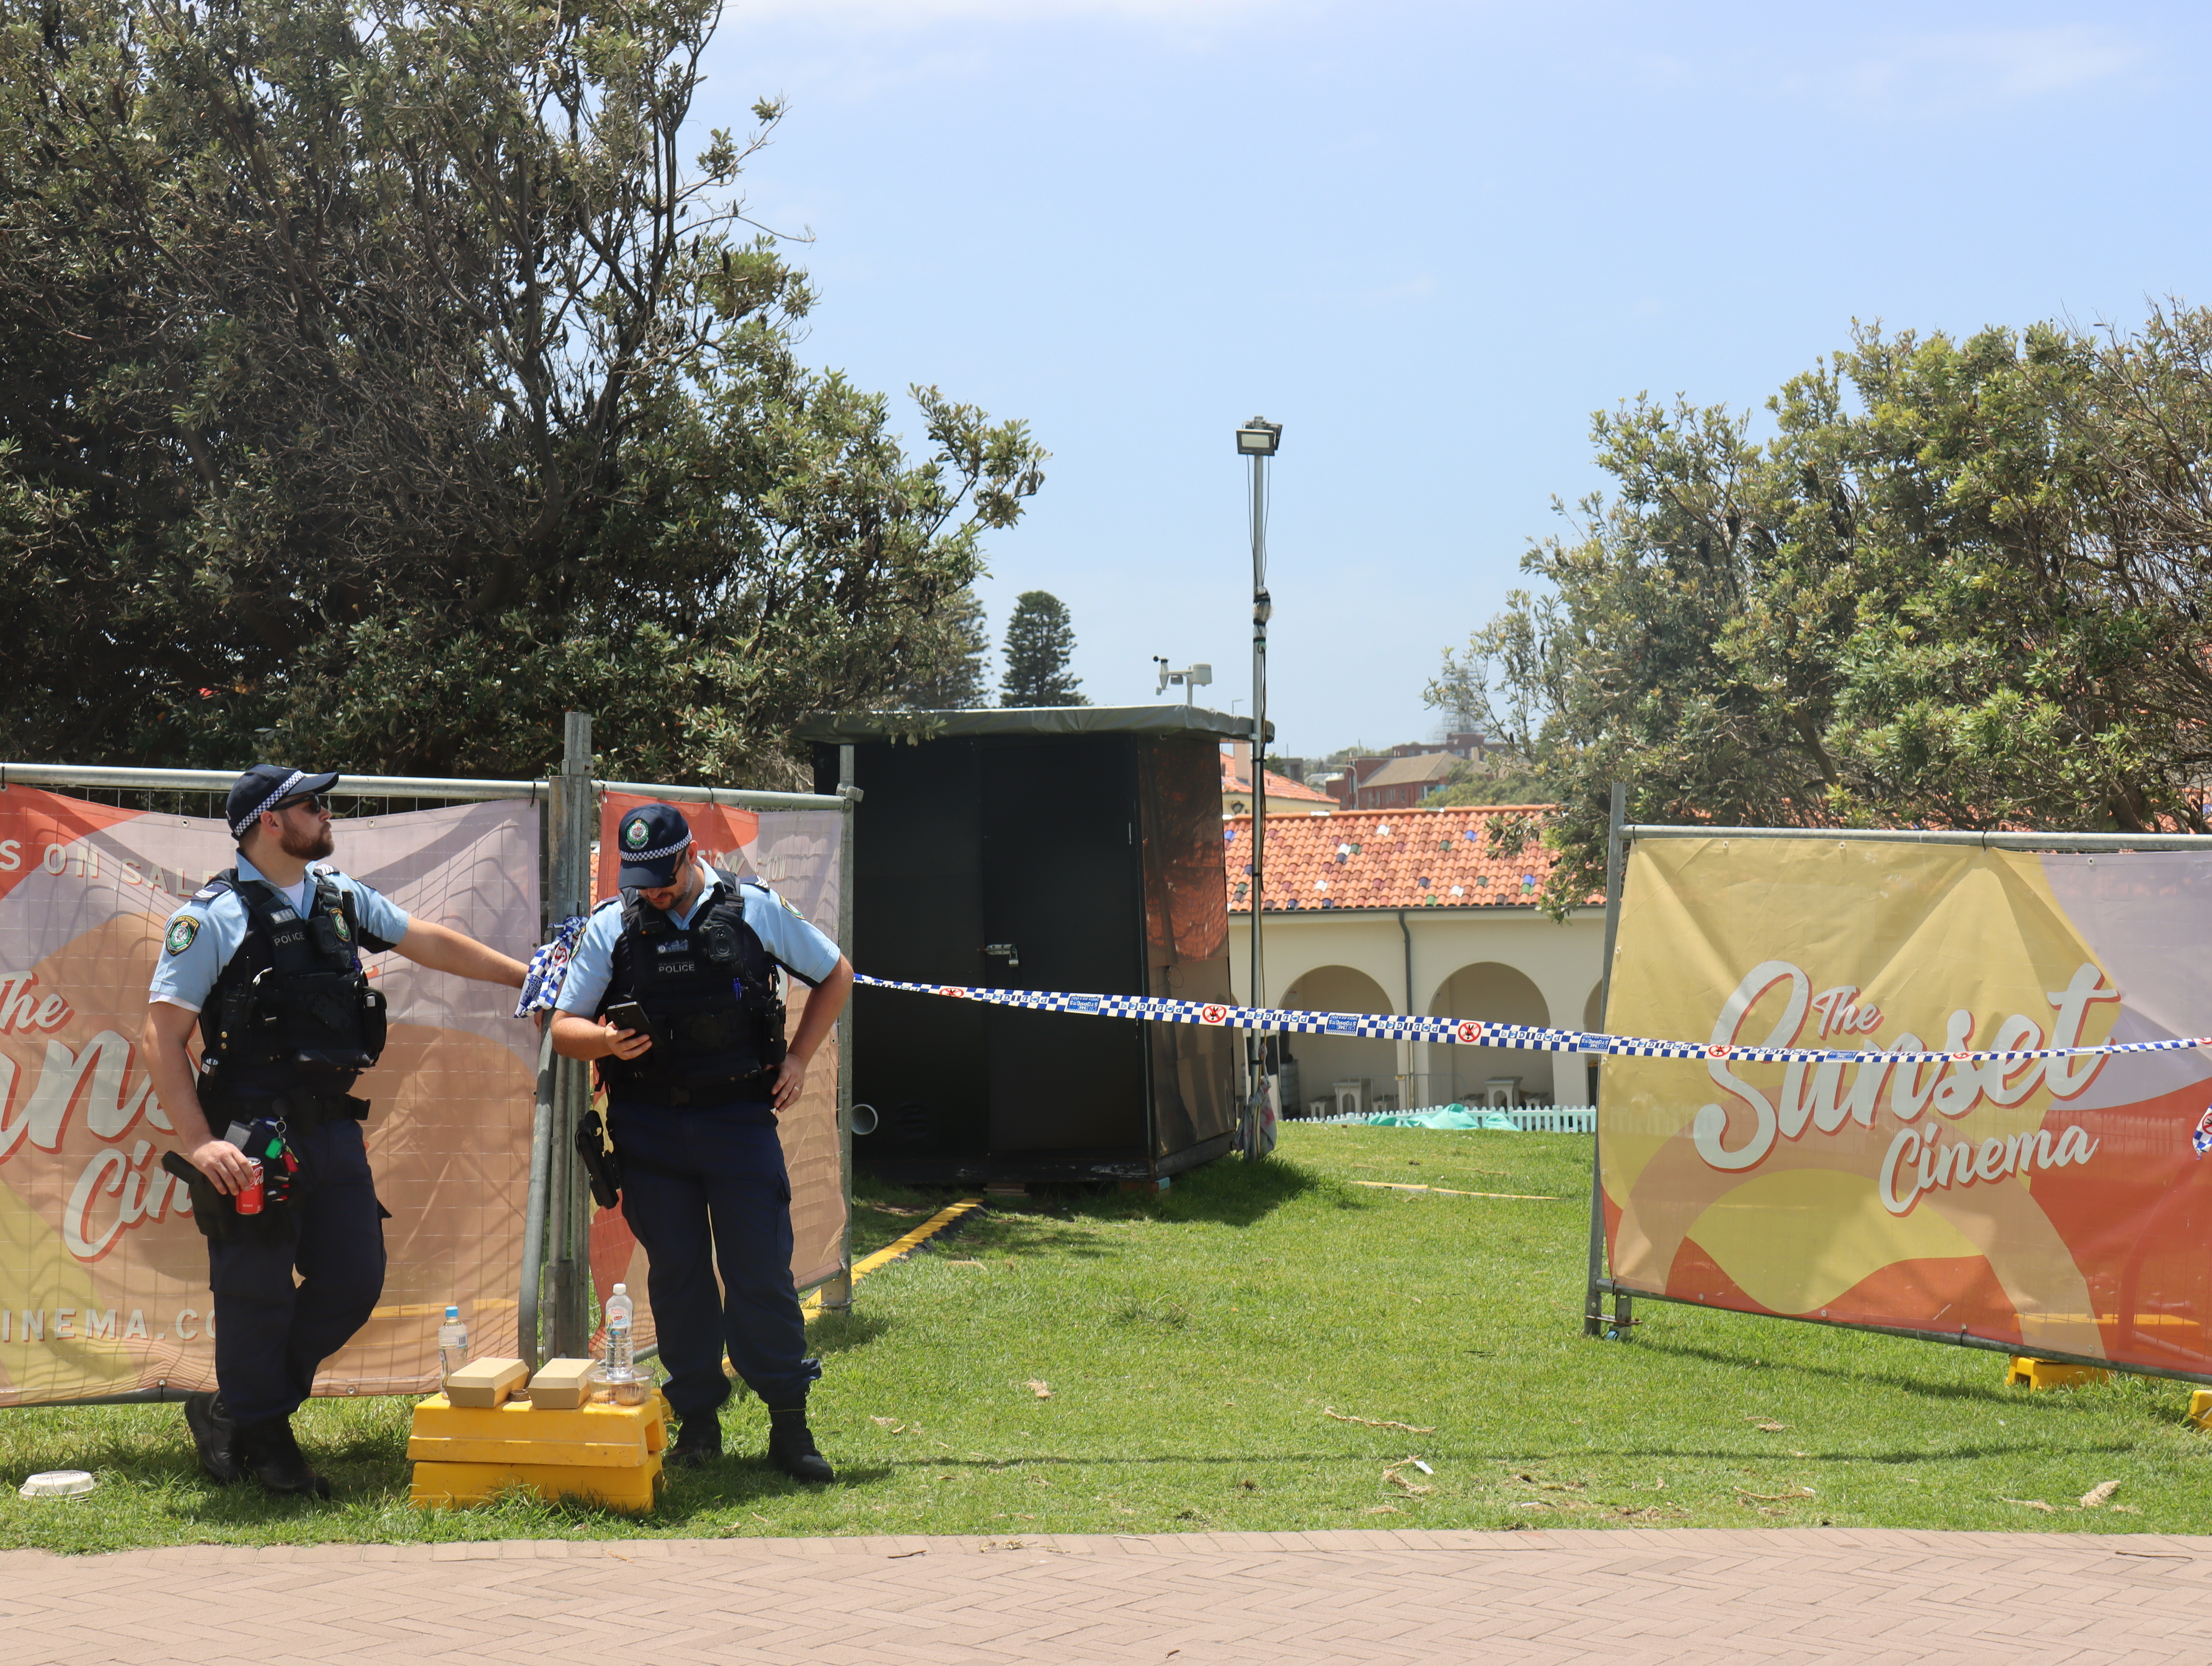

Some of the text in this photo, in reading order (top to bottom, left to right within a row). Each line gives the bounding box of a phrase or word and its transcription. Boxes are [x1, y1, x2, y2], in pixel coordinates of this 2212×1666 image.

[43, 843, 99, 879] ON
[765, 855, 787, 882] NOW
[658, 964, 695, 973] POLICE
[521, 976, 539, 1004] STOPPERS
[1812, 986, 1884, 1040] The
[1693, 960, 2120, 1173] Sunset
[1879, 1123, 2100, 1216] Cinema
